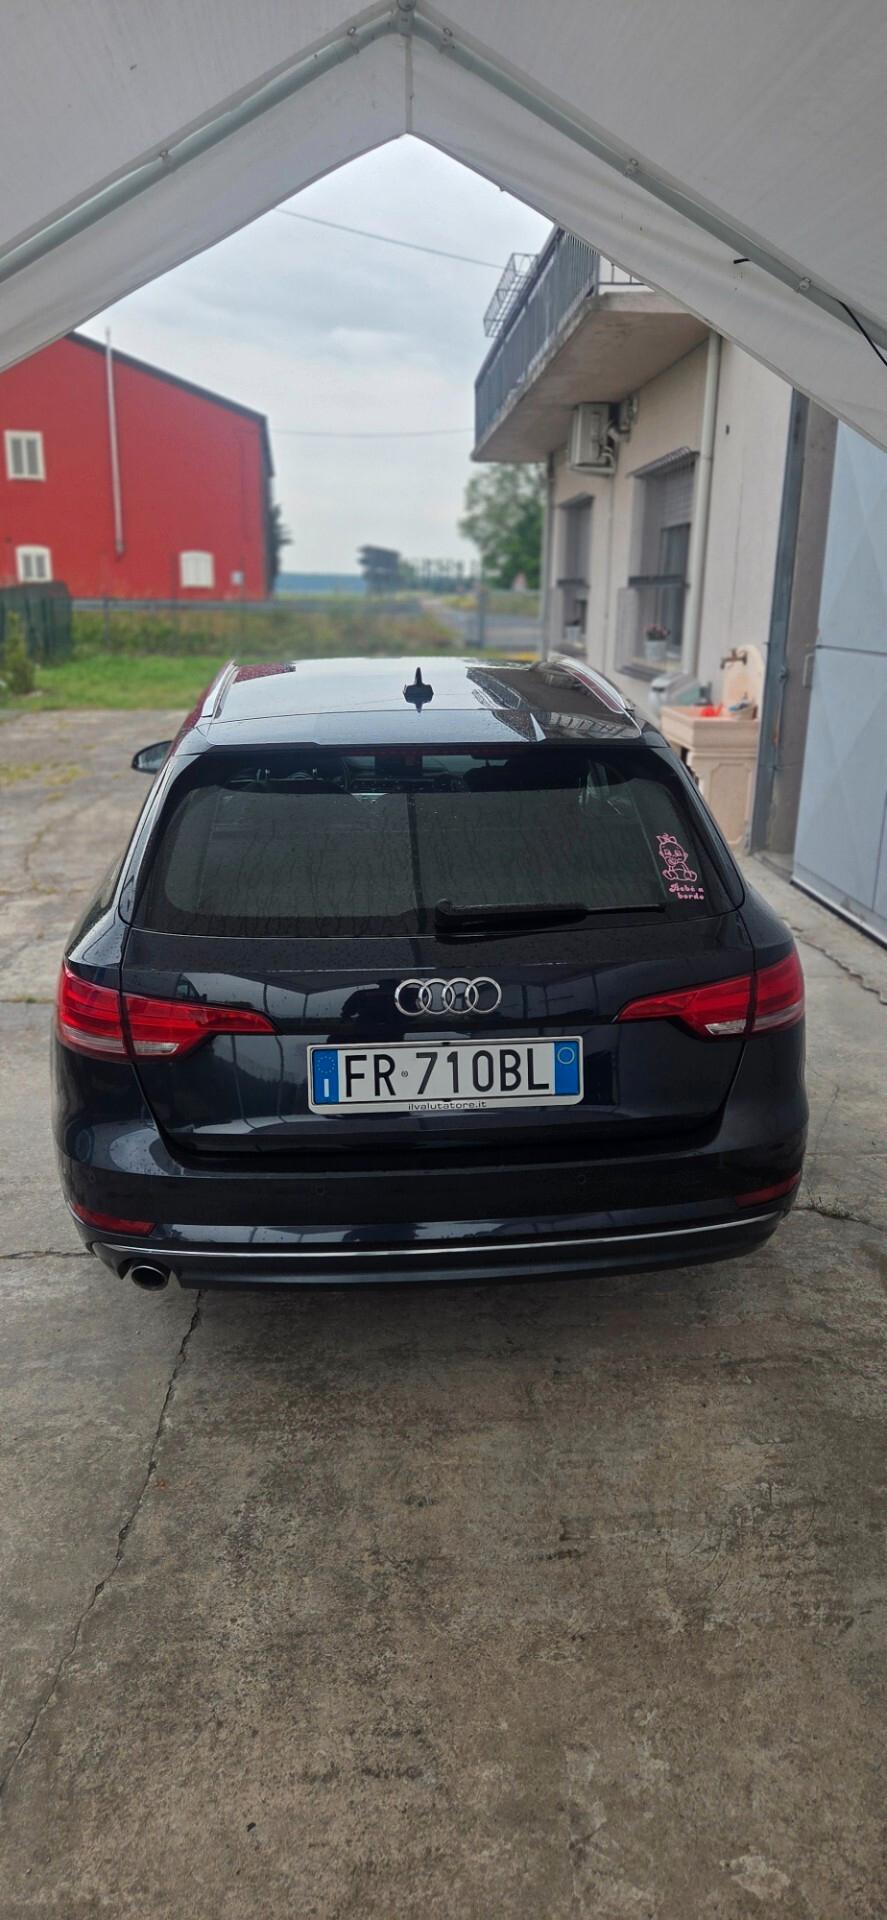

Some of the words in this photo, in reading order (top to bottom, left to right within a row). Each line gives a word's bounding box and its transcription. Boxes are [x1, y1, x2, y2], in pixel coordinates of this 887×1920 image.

[345, 1053, 397, 1098] FR
[415, 1047, 550, 1096] 710BL
[407, 1100, 488, 1111] ilvalutatore.it
